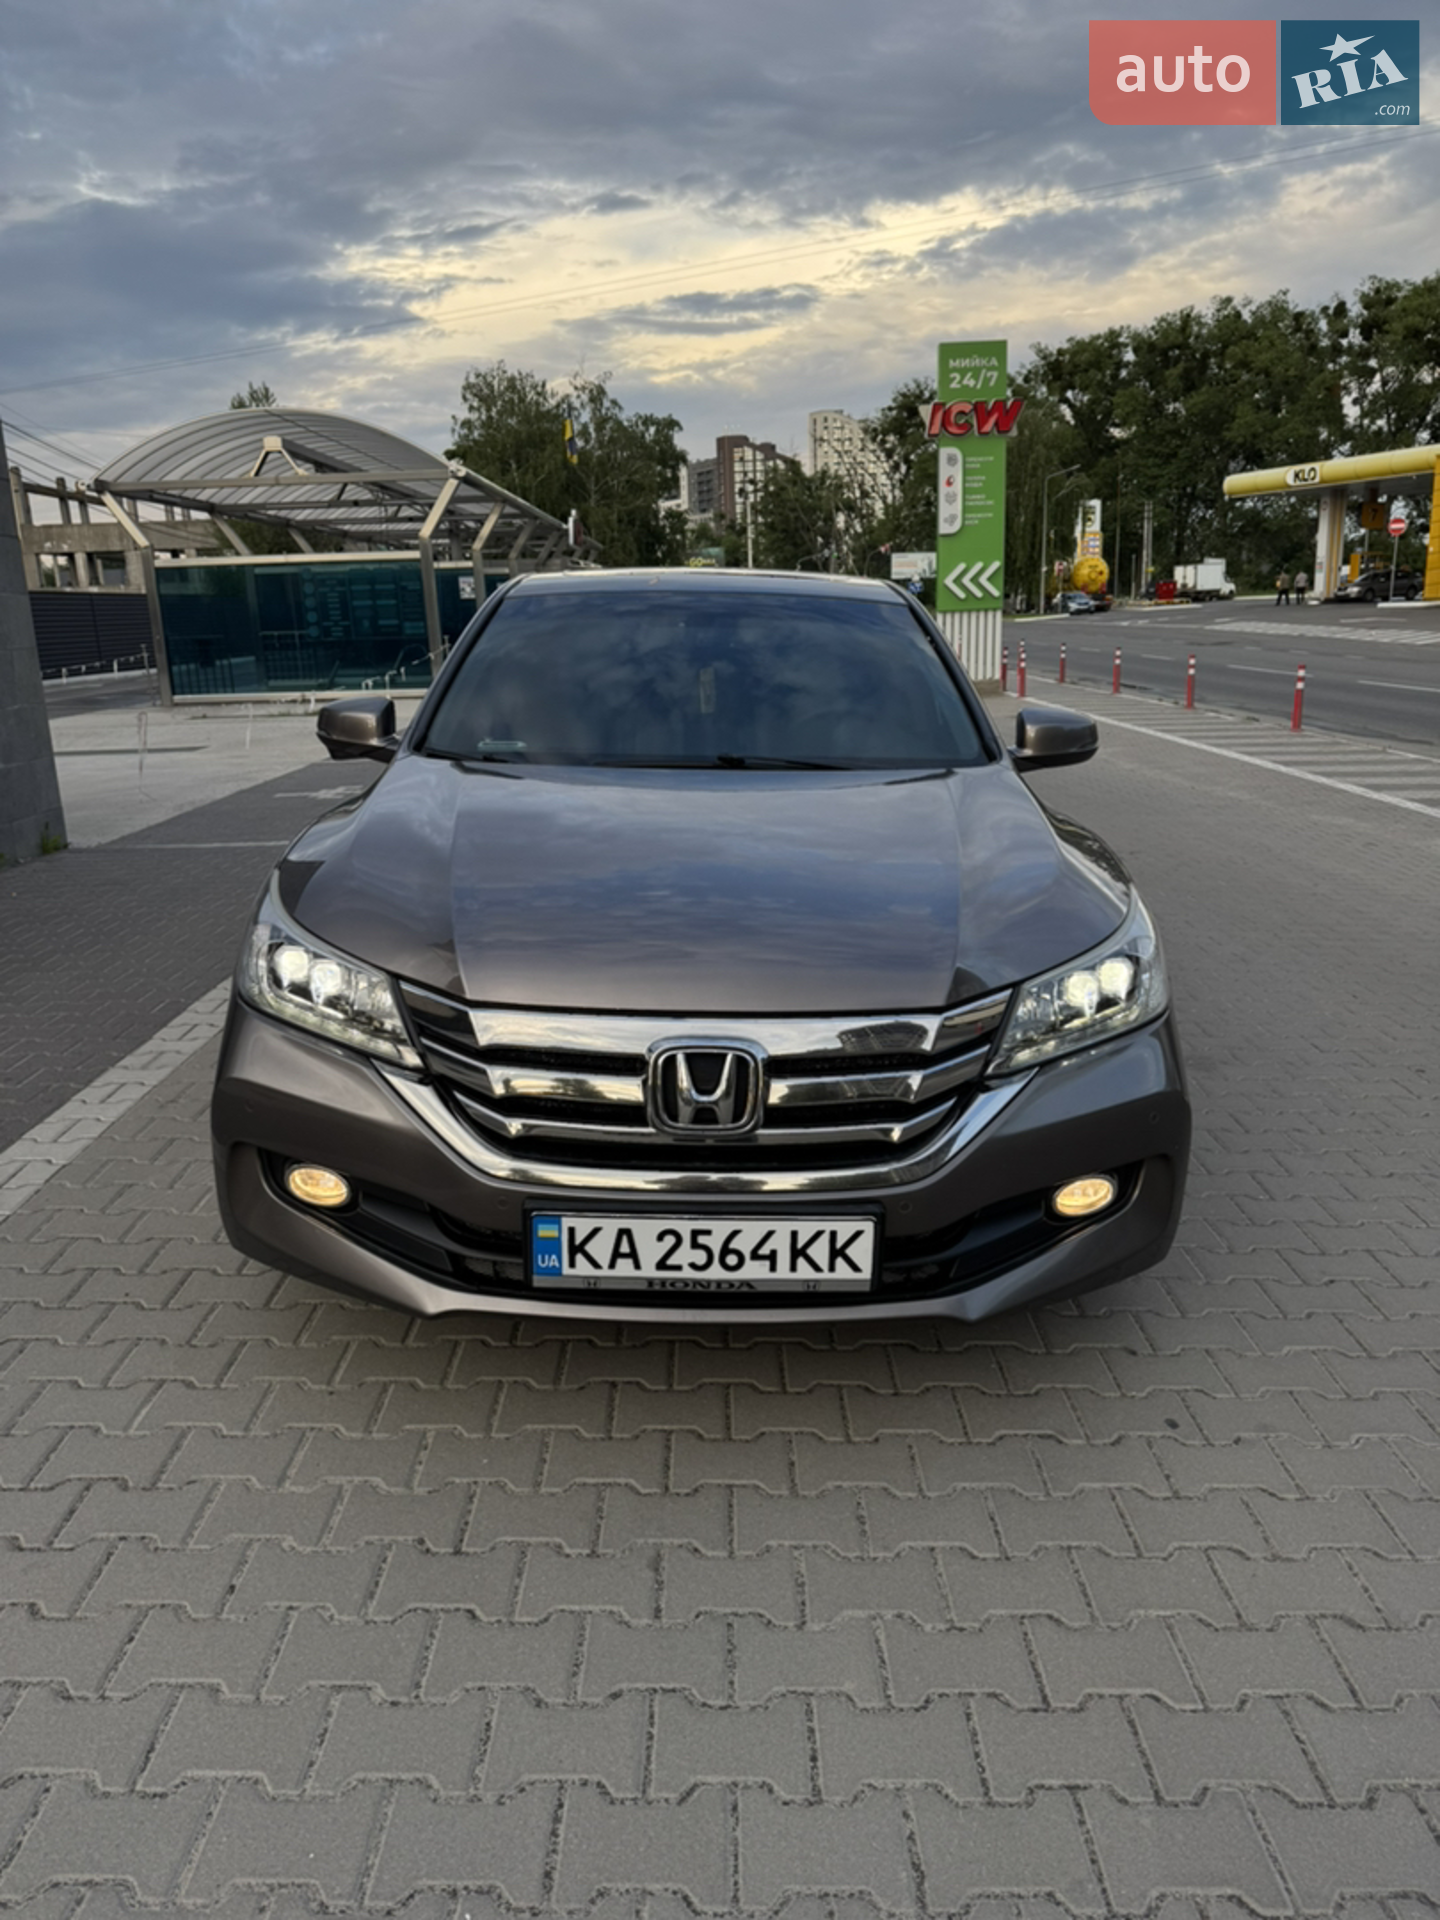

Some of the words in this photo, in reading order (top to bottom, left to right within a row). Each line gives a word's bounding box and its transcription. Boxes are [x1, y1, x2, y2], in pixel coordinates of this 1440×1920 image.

[949, 355, 999, 369] МИЙКА
[949, 369, 999, 389] 24/7
[927, 398, 1023, 437] ICW
[1293, 466, 1317, 483] KLO
[654, 1228, 779, 1274] 2564
[537, 1254, 560, 1268] UA
[646, 1280, 757, 1291] HONDA
